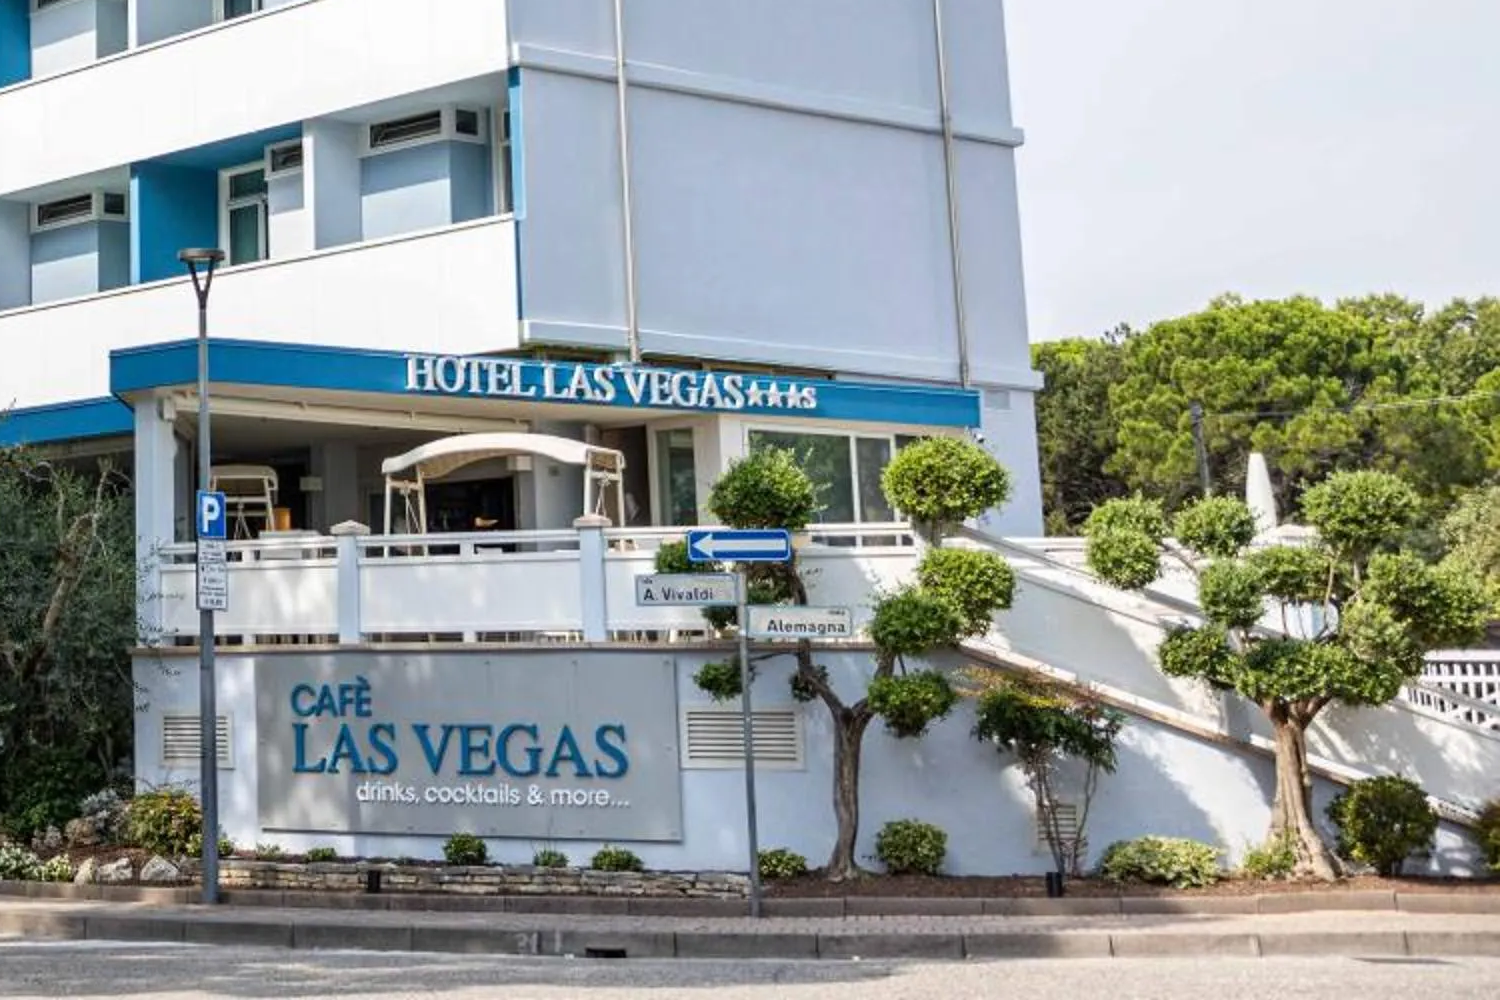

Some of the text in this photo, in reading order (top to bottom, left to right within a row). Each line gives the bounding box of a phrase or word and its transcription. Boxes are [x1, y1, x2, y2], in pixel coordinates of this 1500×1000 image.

[404, 353, 537, 397] HOTEL
[542, 362, 616, 403] LAS
[621, 369, 745, 410] VEGAS
[202, 495, 221, 533] P
[643, 586, 714, 601] A. Vivaldi
[767, 619, 846, 635] Alemagna
[290, 676, 373, 718] CAFÈ
[291, 722, 630, 779] LAS VEGAS
[355, 781, 420, 804] drinks,
[424, 782, 520, 806] cocktails
[526, 784, 544, 807] &
